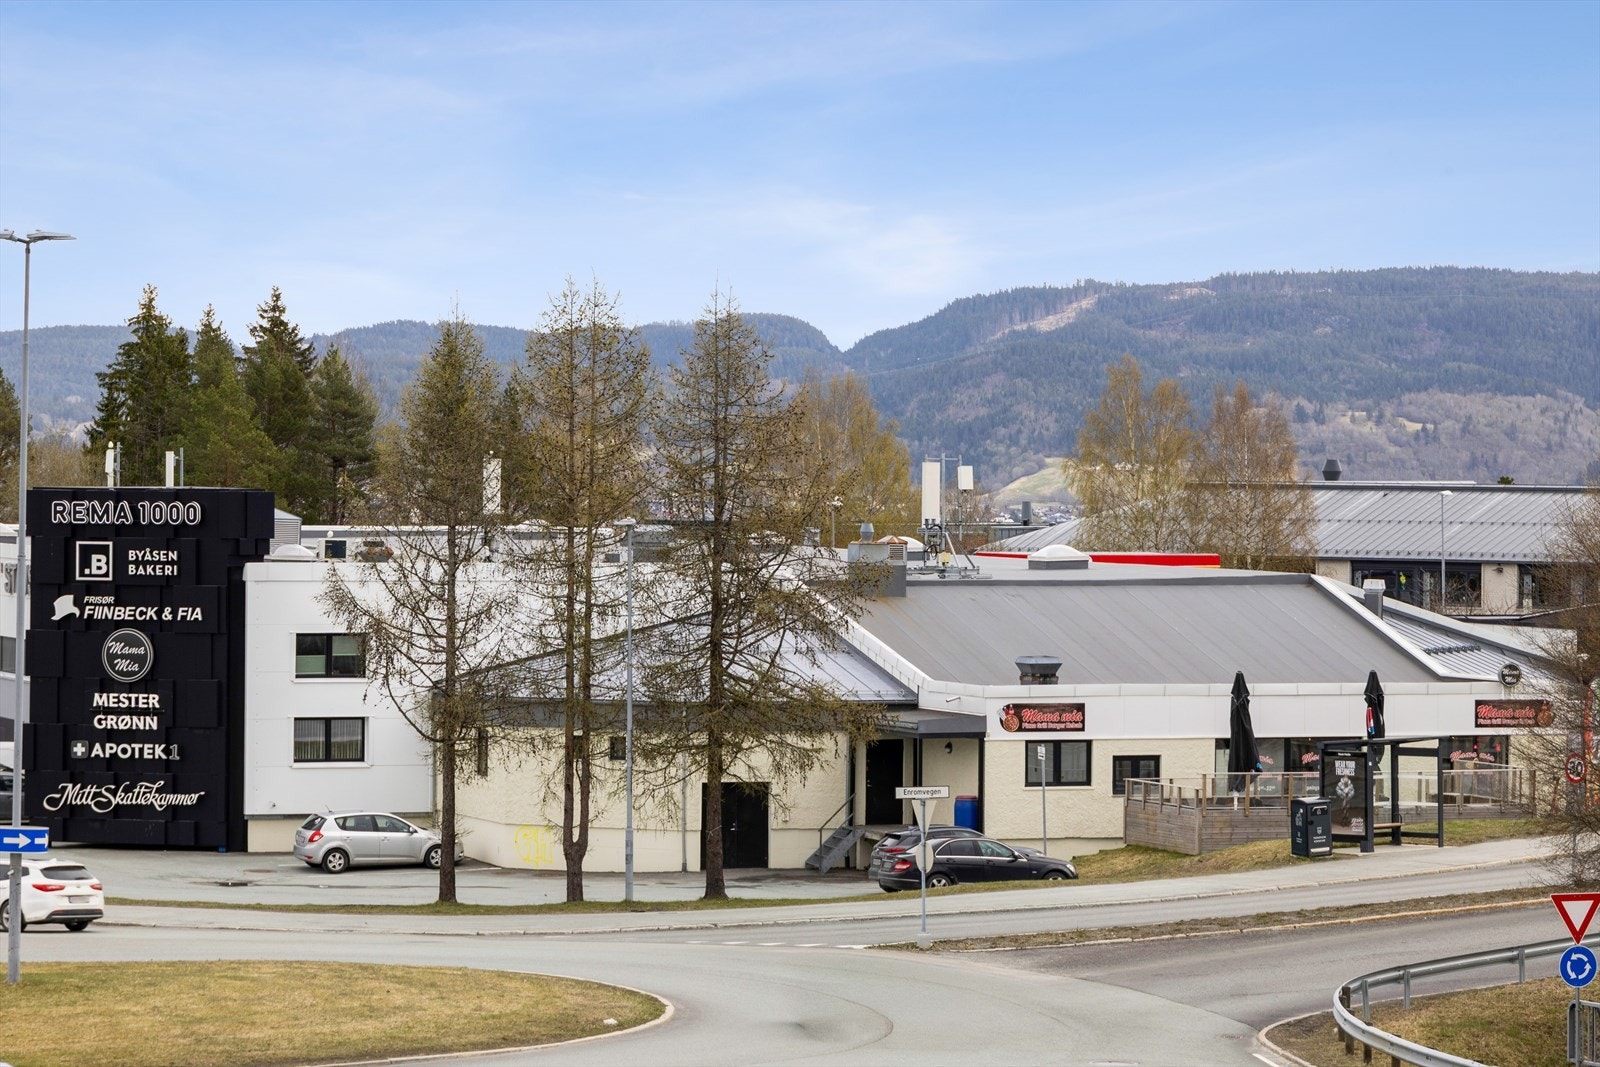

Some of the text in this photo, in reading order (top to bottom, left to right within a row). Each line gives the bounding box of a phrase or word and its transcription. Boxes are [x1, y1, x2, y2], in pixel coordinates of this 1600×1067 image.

[51, 500, 201, 525] REMA 1000
[128, 548, 178, 561] BYÅSEN
[128, 564, 178, 576] BAKERI
[83, 596, 115, 604] FRISØR
[83, 605, 203, 621] FIINBECK & FIA
[108, 641, 146, 655] Mama
[113, 658, 140, 672] Mia
[92, 693, 160, 708] MESTER
[1022, 709, 1083, 722] Mama mia
[1477, 705, 1513, 718] Mama
[93, 715, 158, 730] GRØNN
[90, 742, 180, 760] APOTEK 1
[1568, 760, 1584, 777] 30
[43, 781, 205, 813] Mitt Skattekammer
[903, 788, 942, 796] Enromvegen
